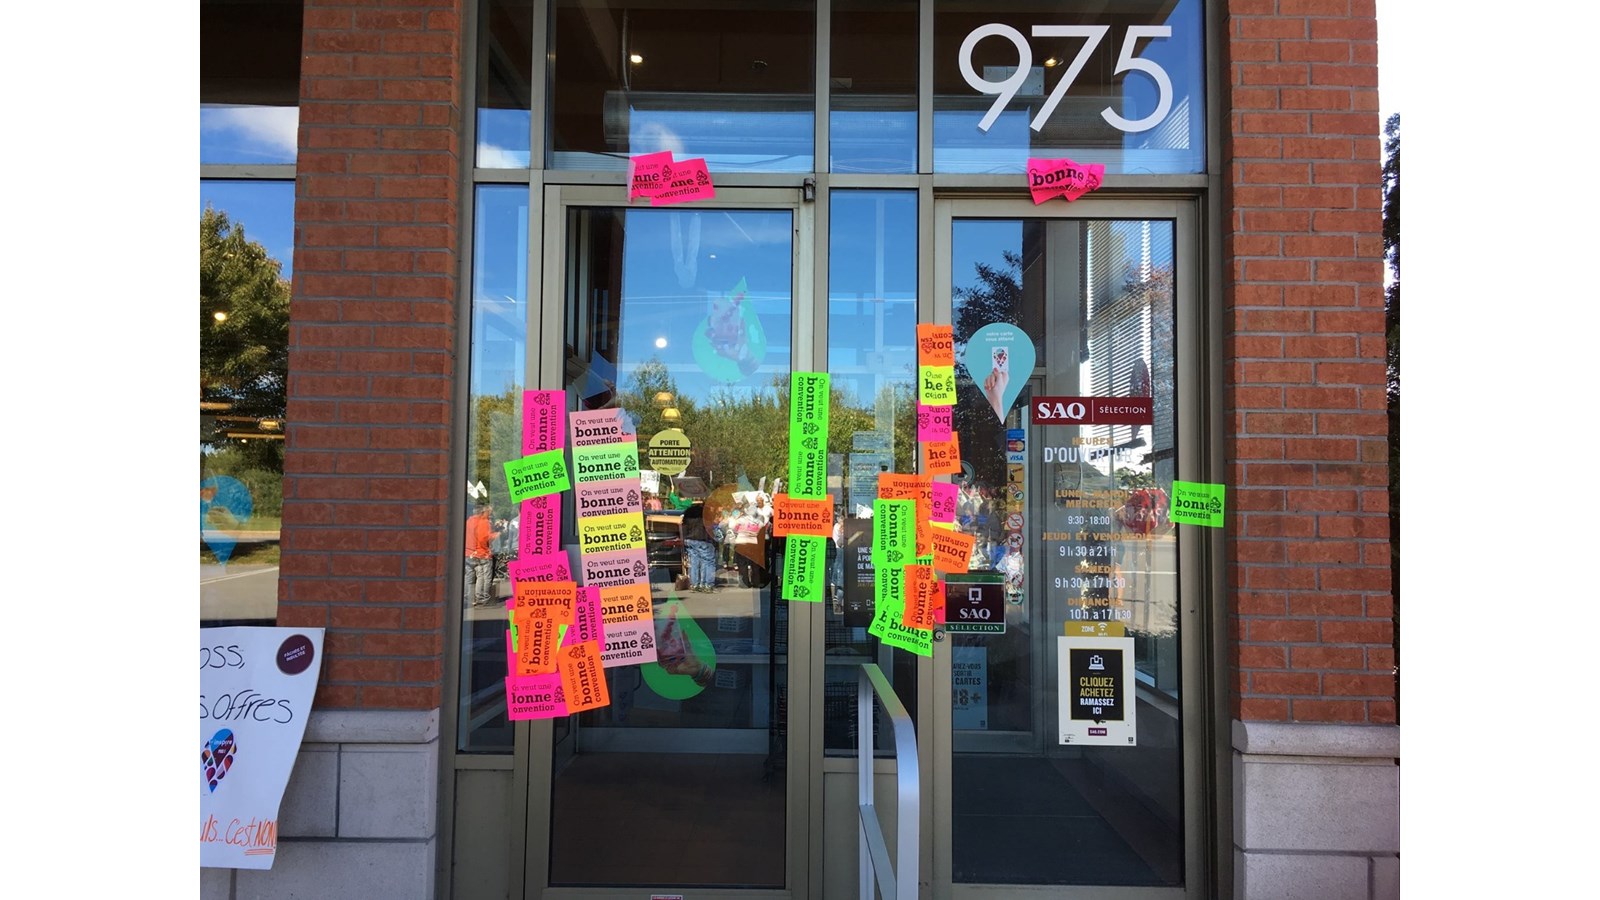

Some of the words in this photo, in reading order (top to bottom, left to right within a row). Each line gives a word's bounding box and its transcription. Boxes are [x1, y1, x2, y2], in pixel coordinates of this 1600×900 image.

[958, 23, 1173, 133] 975
[1032, 168, 1084, 186] bonne
[819, 378, 825, 390] On
[797, 376, 805, 422] convention
[806, 377, 818, 420] bonne
[1038, 402, 1086, 420] SAQ
[1100, 406, 1146, 414] SÉLECTION
[536, 408, 548, 451] bonne
[575, 426, 618, 438] bonne
[576, 436, 622, 446] convention
[1072, 437, 1114, 446] HEURES
[578, 462, 621, 474] bonne
[802, 452, 815, 496] bonne
[816, 450, 824, 496] convention
[579, 472, 625, 482] convention
[580, 496, 624, 508] bonne
[582, 506, 628, 517] convention
[778, 509, 819, 521] bonne
[901, 505, 908, 516] On
[889, 504, 900, 547] bonne
[1068, 516, 1084, 525] 9:30
[1090, 516, 1110, 525] 18:00
[532, 512, 544, 555] bonne
[545, 509, 553, 554] convention
[1042, 532, 1071, 540] JEUDI
[584, 532, 627, 545] bonne
[585, 542, 632, 554] convention
[812, 542, 818, 552] On
[1060, 546, 1066, 557] 9
[1076, 546, 1087, 557] 30
[1097, 546, 1108, 556] 21
[1111, 546, 1116, 556] h
[788, 539, 797, 585] convention
[797, 539, 811, 583] bonne
[587, 568, 630, 580] bonne
[1055, 578, 1060, 588] 9
[1063, 578, 1068, 588] h
[1071, 578, 1081, 588] 30
[1093, 578, 1104, 588] 17
[1106, 578, 1112, 588] h
[1114, 578, 1126, 588] 30
[525, 589, 571, 597] convention
[528, 598, 571, 610] bonne
[916, 582, 927, 624] bonne
[960, 608, 991, 620] SAQ
[1070, 609, 1080, 619] 10
[1083, 609, 1088, 619] h
[1102, 609, 1113, 619] 17
[1115, 609, 1120, 619] h
[1122, 610, 1132, 619] 30
[529, 621, 543, 665] bonne
[544, 618, 552, 665] convention
[522, 652, 528, 663] On
[577, 661, 592, 706] bonne
[587, 656, 601, 702] convention
[1080, 677, 1114, 687] CLIQUEZ
[1080, 688, 1114, 697] ACHETEZ
[573, 695, 580, 706] On
[1080, 698, 1114, 706] RAMASSEZ
